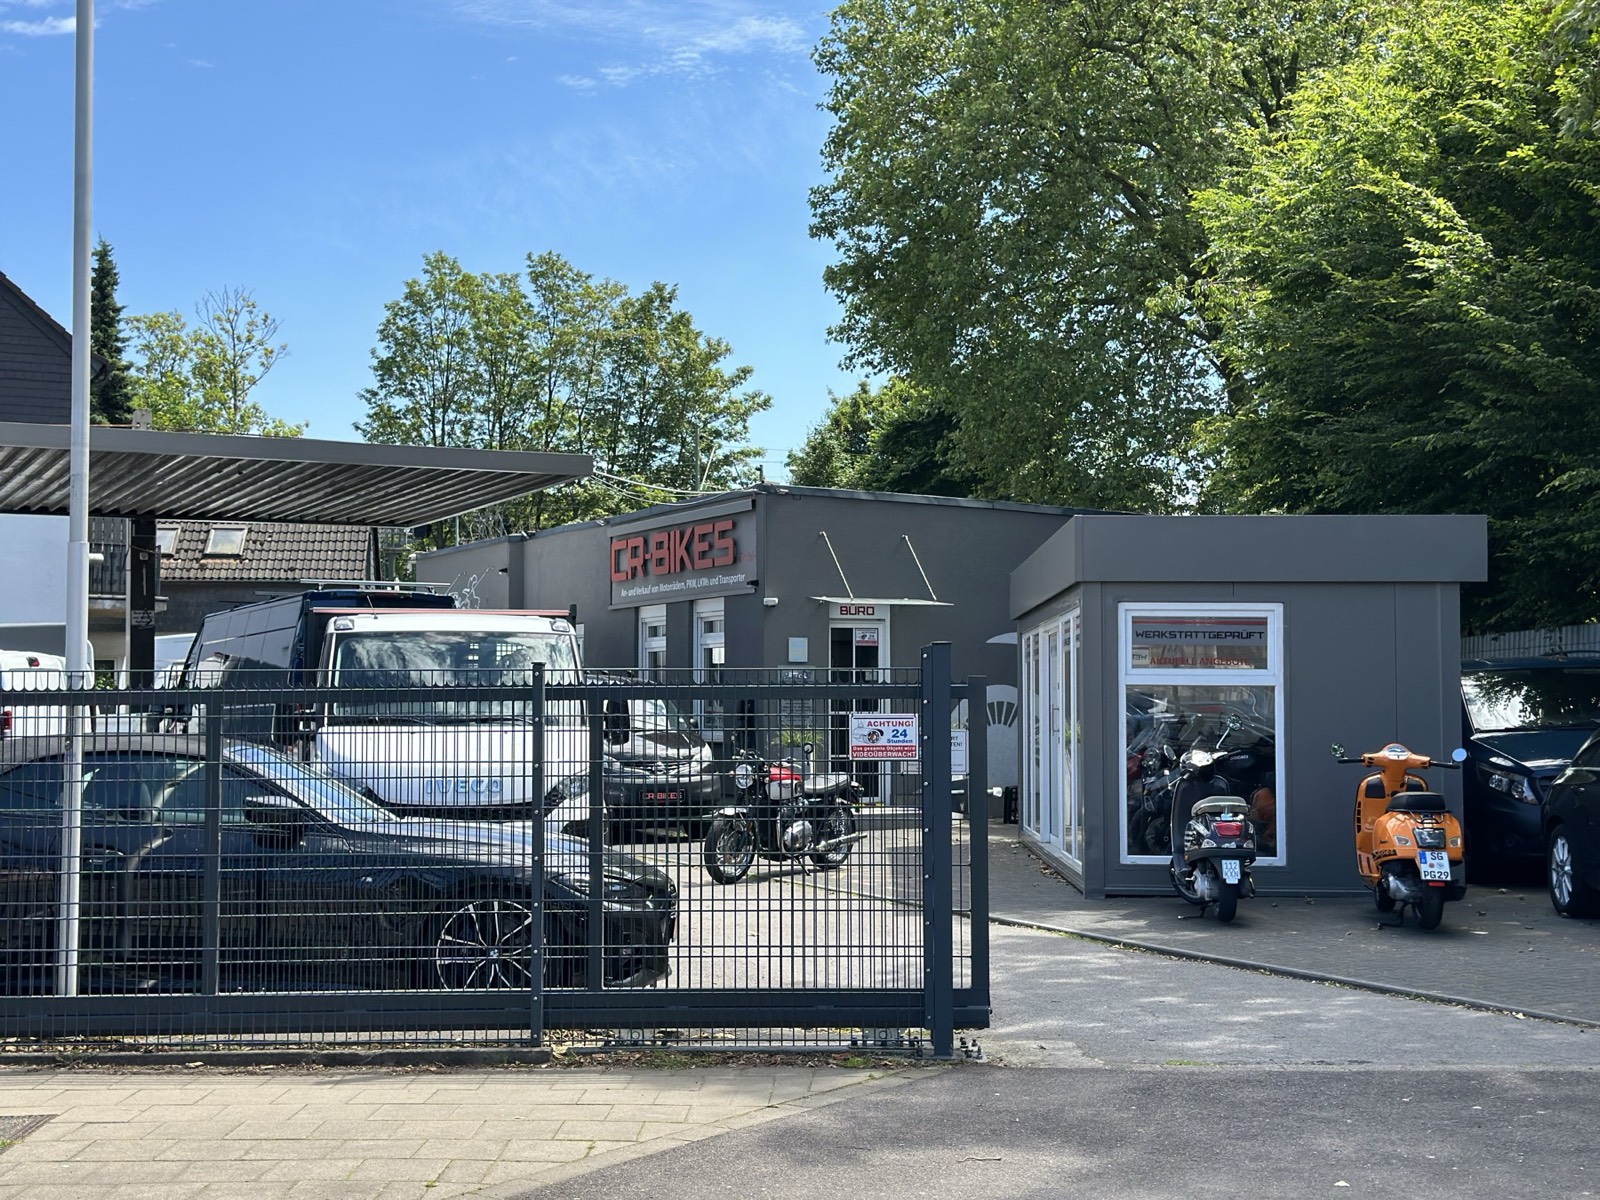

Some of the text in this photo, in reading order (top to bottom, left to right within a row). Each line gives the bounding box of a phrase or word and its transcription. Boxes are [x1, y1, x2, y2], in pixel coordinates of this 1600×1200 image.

[611, 520, 734, 582] CR-BIKES
[652, 584, 660, 593] von
[710, 575, 719, 585] und
[720, 573, 745, 587] Transporter
[840, 603, 875, 616] BÜRO
[1136, 630, 1265, 640] WERKSTATTGEPRÜFT
[891, 728, 908, 739] 24
[425, 779, 502, 794] IVECO
[1430, 852, 1444, 861] SG
[1224, 862, 1238, 870] 112
[1224, 870, 1239, 878] KXN
[1423, 870, 1449, 880] PG29
